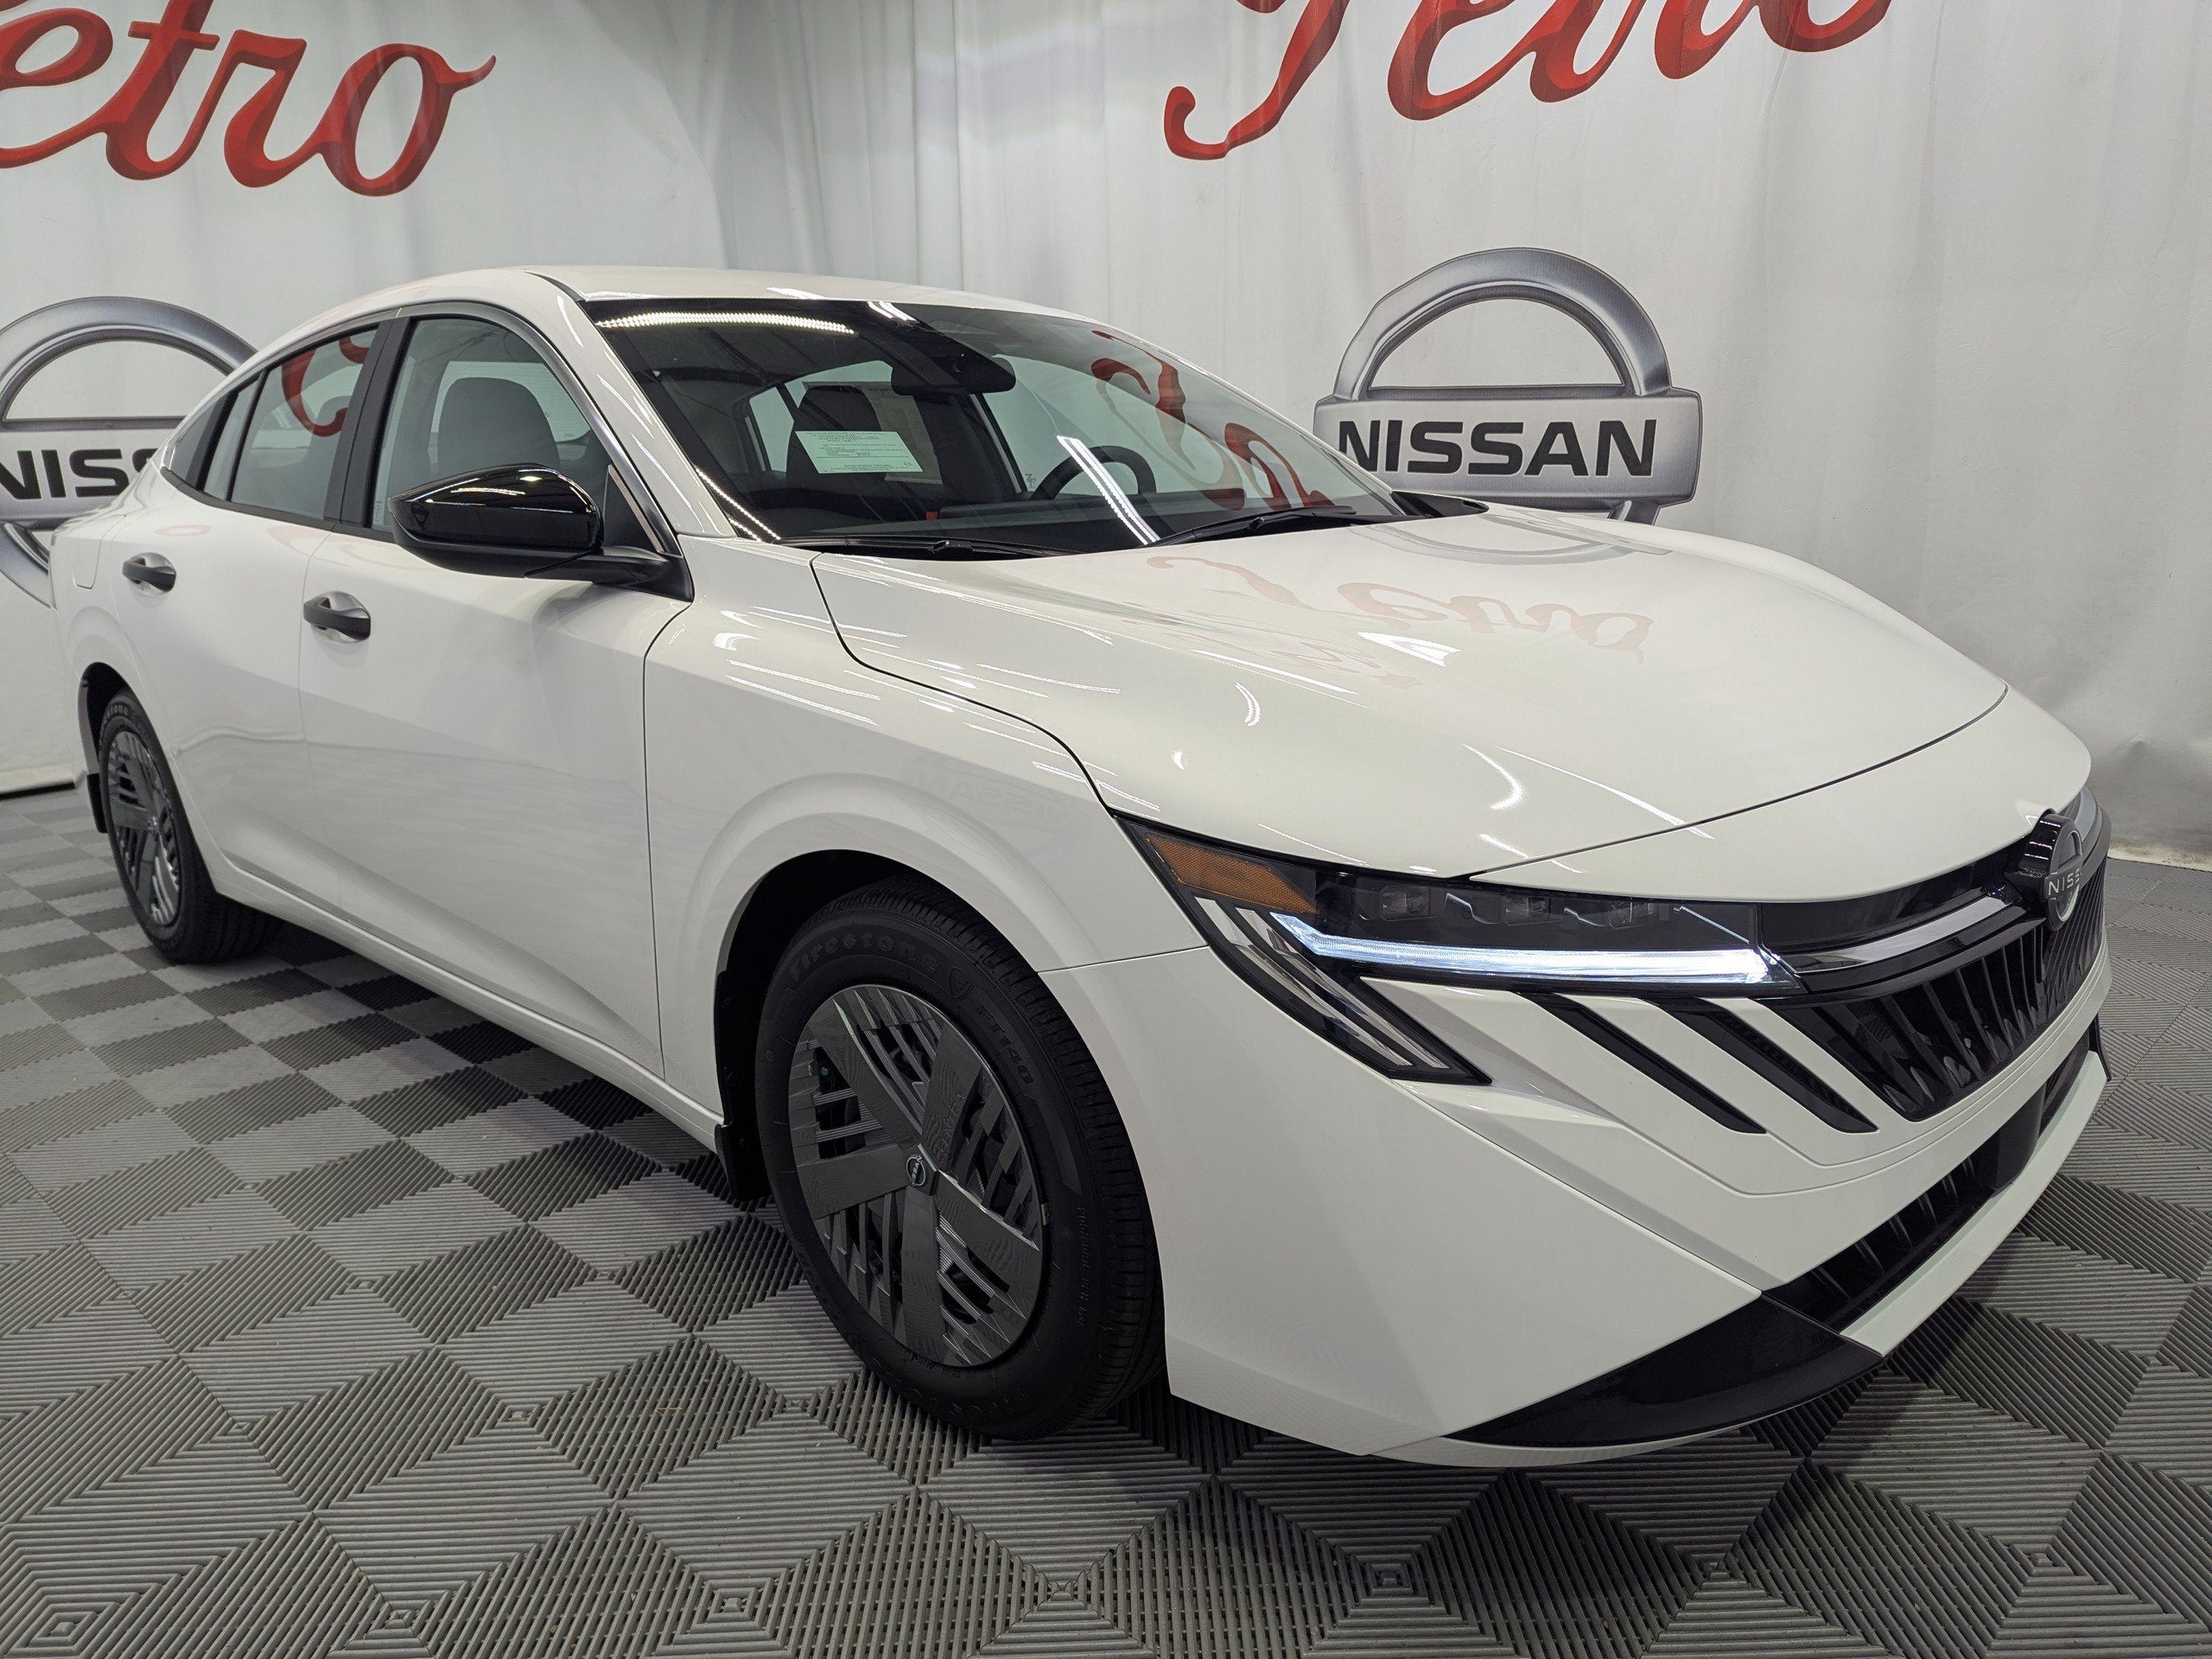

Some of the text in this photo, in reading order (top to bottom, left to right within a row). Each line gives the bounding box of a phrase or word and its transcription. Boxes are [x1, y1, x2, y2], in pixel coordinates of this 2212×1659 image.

[0, 0, 497, 197] etro
[0, 448, 159, 499] NIS
[1339, 419, 1657, 477] NISSAN
